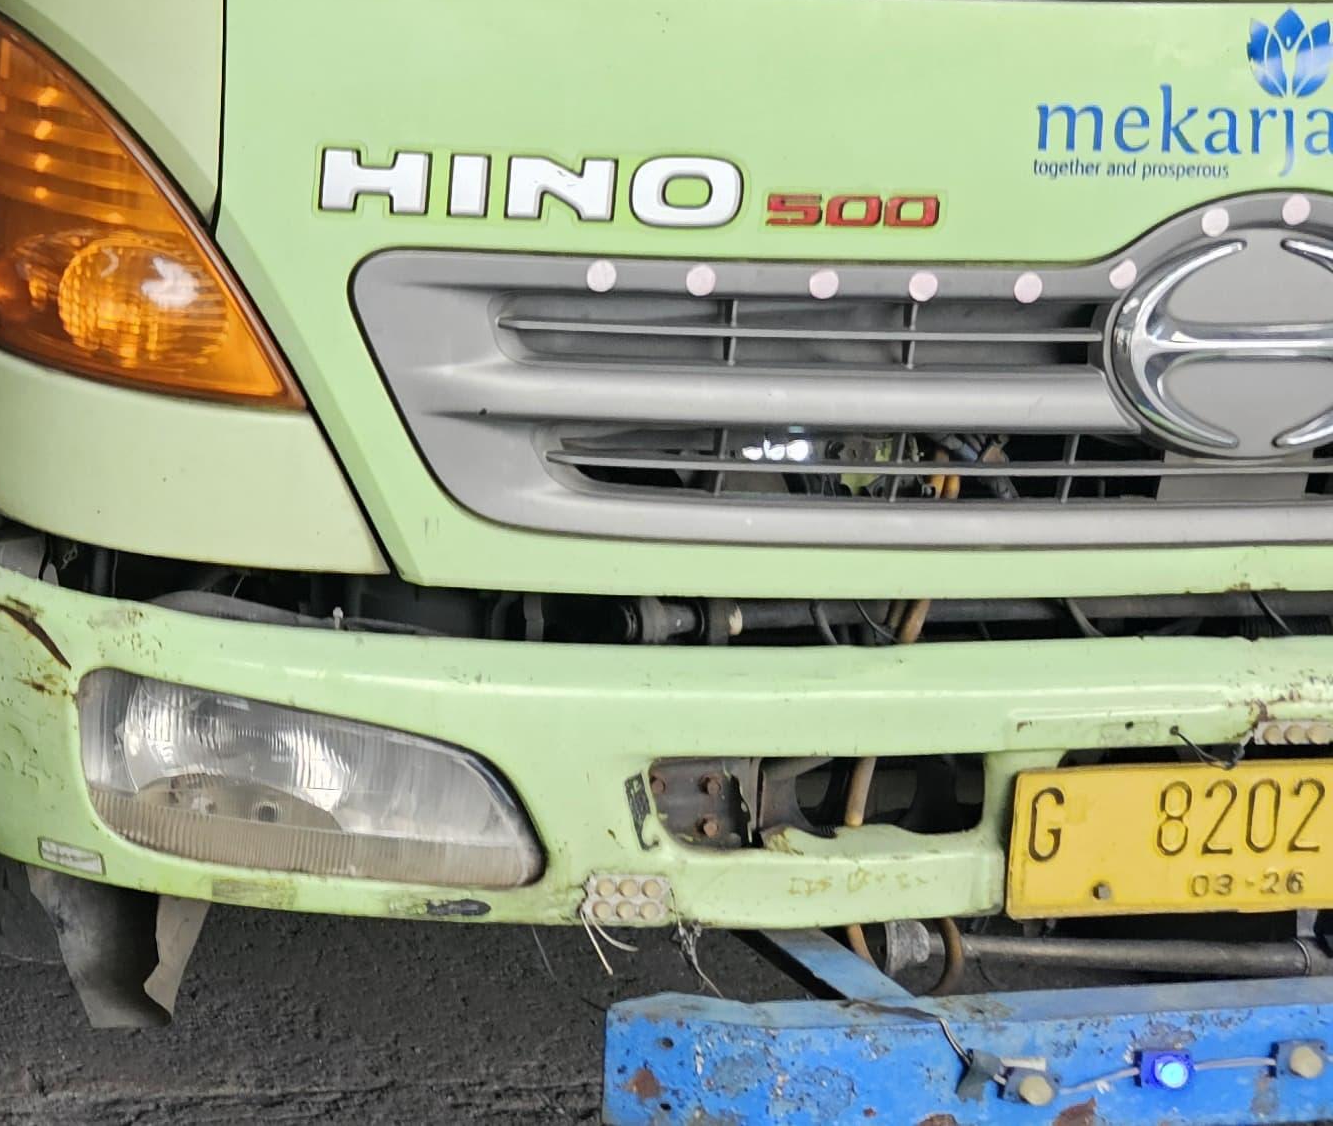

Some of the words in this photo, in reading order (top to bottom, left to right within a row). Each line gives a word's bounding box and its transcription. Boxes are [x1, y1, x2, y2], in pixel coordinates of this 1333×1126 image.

[319, 146, 745, 228] HINO
[765, 191, 942, 228] 500
[1033, 158, 1101, 180] together
[1106, 158, 1136, 178] and
[1141, 163, 1229, 181] prosperous
[1028, 786, 1065, 863] G
[1156, 777, 1326, 857] 8202
